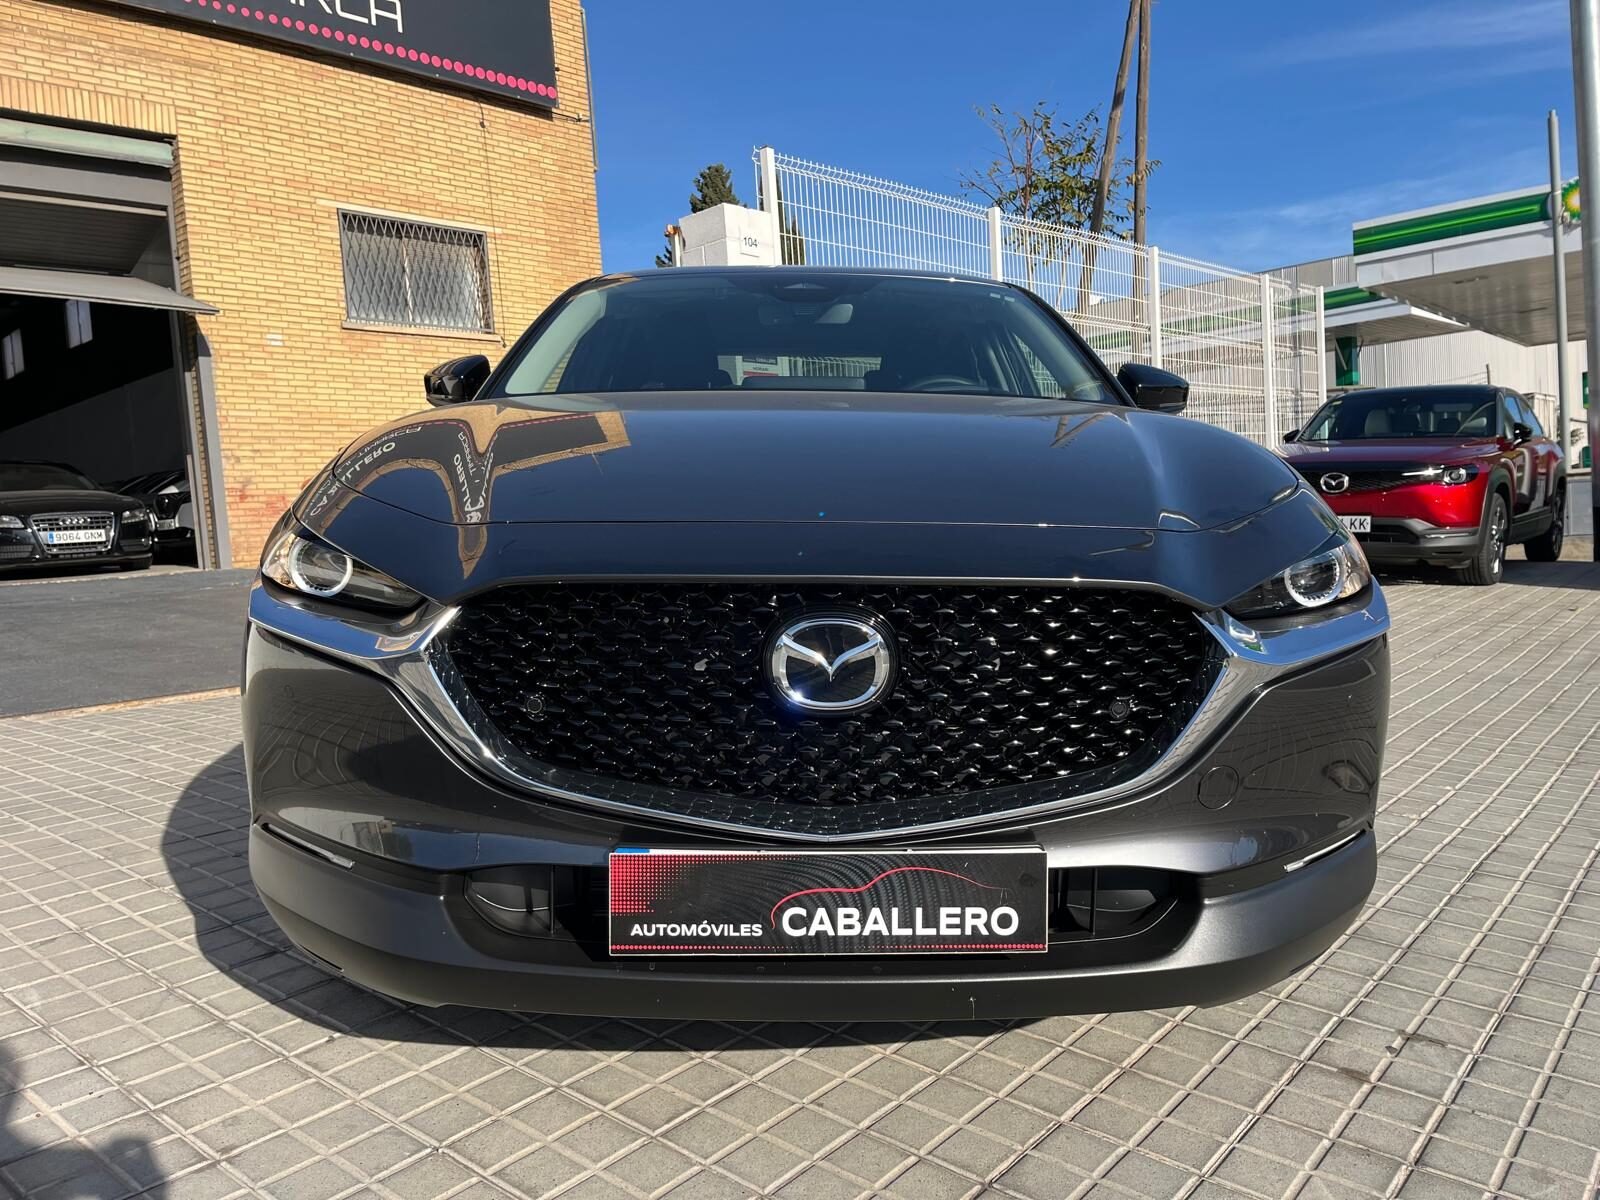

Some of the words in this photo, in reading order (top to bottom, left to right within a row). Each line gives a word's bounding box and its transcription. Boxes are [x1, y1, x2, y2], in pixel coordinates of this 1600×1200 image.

[743, 236, 758, 248] 104
[55, 532, 81, 542] 9064
[630, 920, 763, 937] AUTOMÓVILES
[781, 906, 1019, 937] CABALLERO
